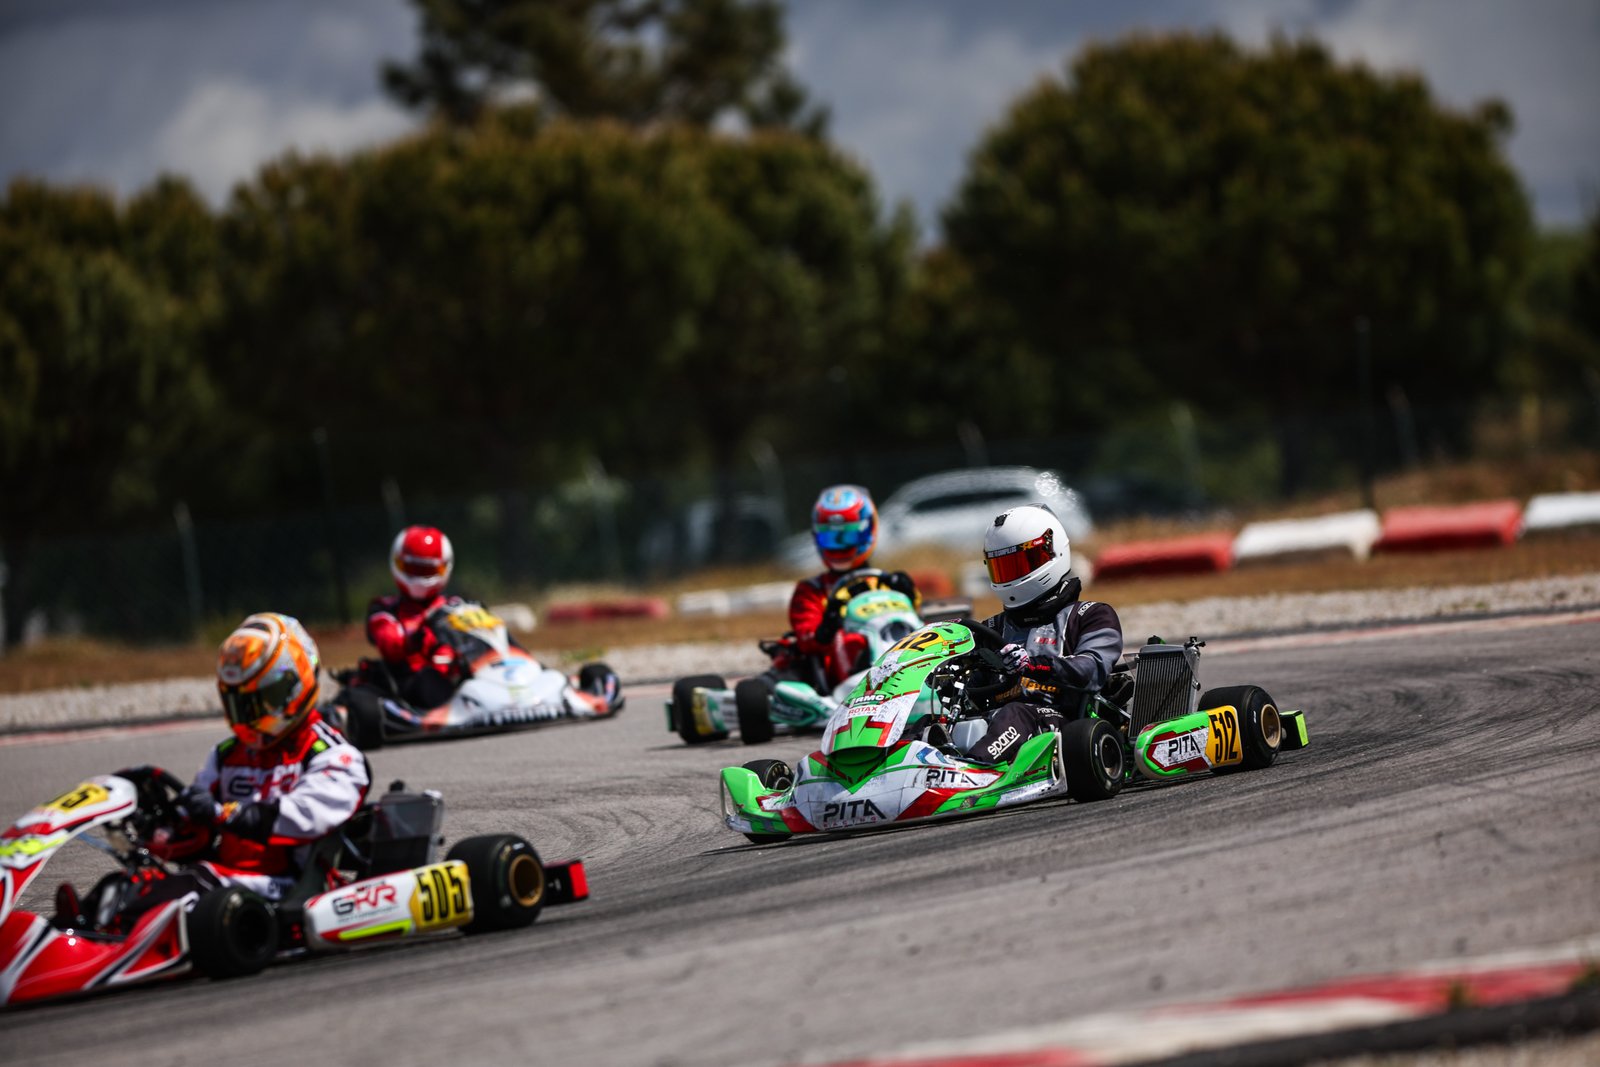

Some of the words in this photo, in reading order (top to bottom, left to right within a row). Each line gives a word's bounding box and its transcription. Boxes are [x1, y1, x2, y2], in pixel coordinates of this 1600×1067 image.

[848, 706, 878, 715] ROTAX
[987, 725, 1018, 757] sparco
[1168, 734, 1200, 757] PITA
[1209, 710, 1238, 763] 512
[926, 769, 978, 786] PITA
[823, 799, 887, 823] PITA
[416, 866, 466, 922] 505
